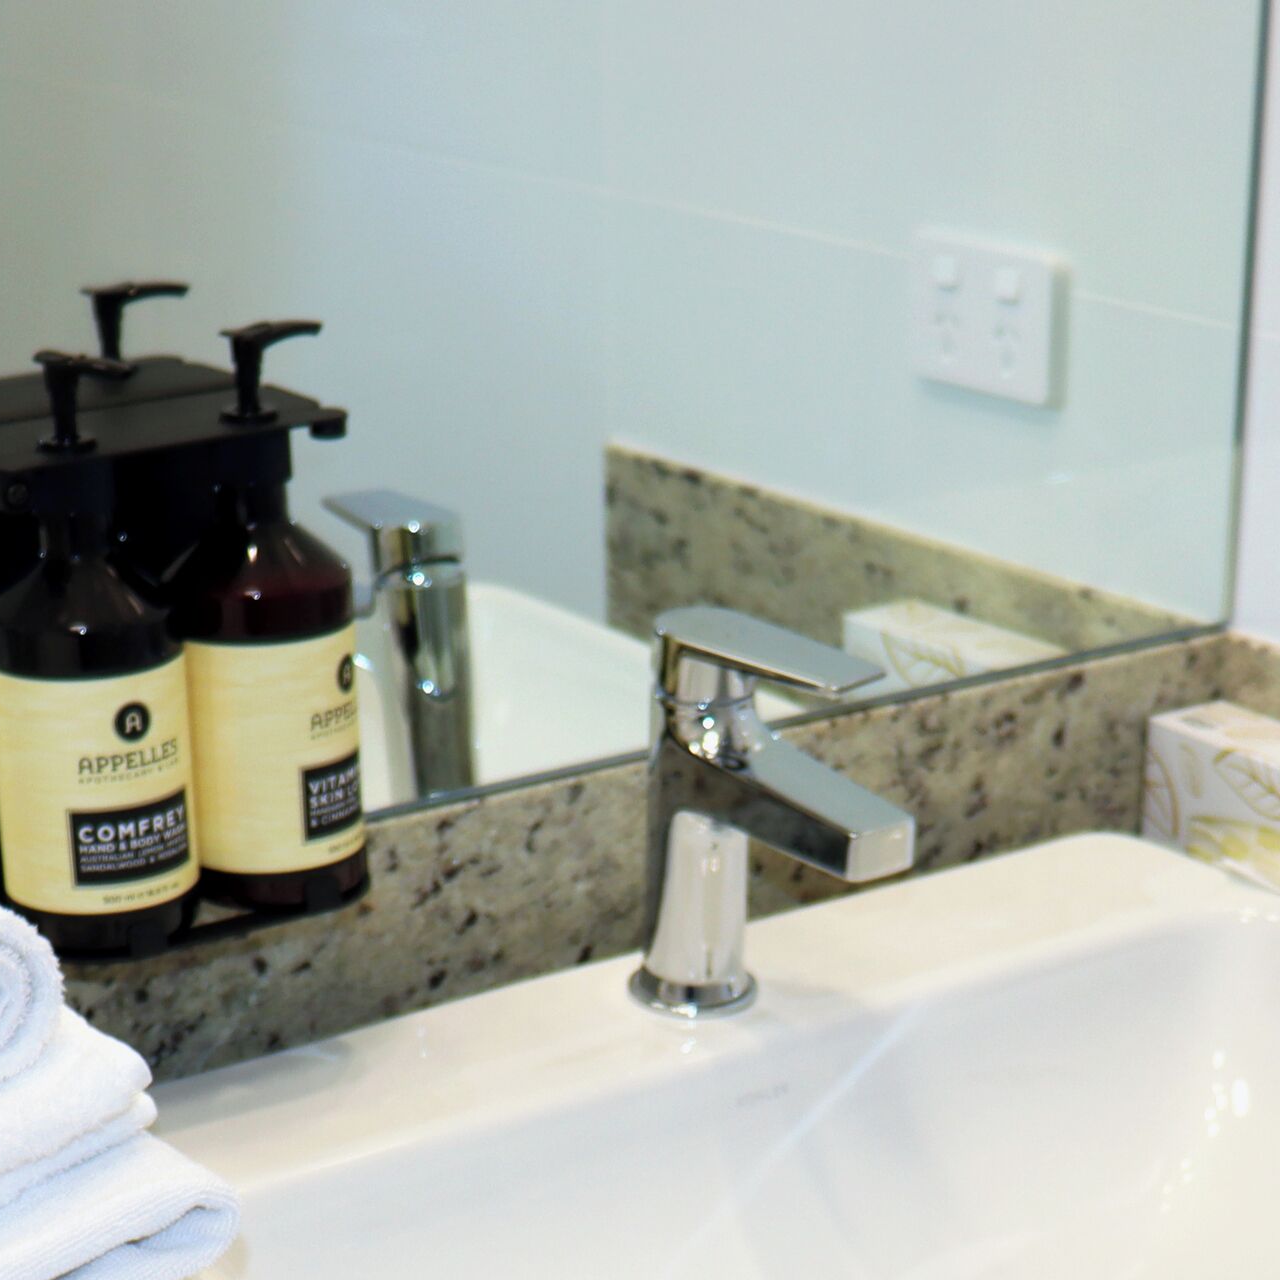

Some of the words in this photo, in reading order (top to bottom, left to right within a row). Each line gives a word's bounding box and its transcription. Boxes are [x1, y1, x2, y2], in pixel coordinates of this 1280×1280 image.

[125, 711, 143, 734] A
[78, 738, 178, 775] APPELLES
[310, 787, 344, 809] SKIN
[78, 804, 184, 844] COMFREY
[79, 842, 116, 855] HAND
[130, 833, 161, 850] BODY
